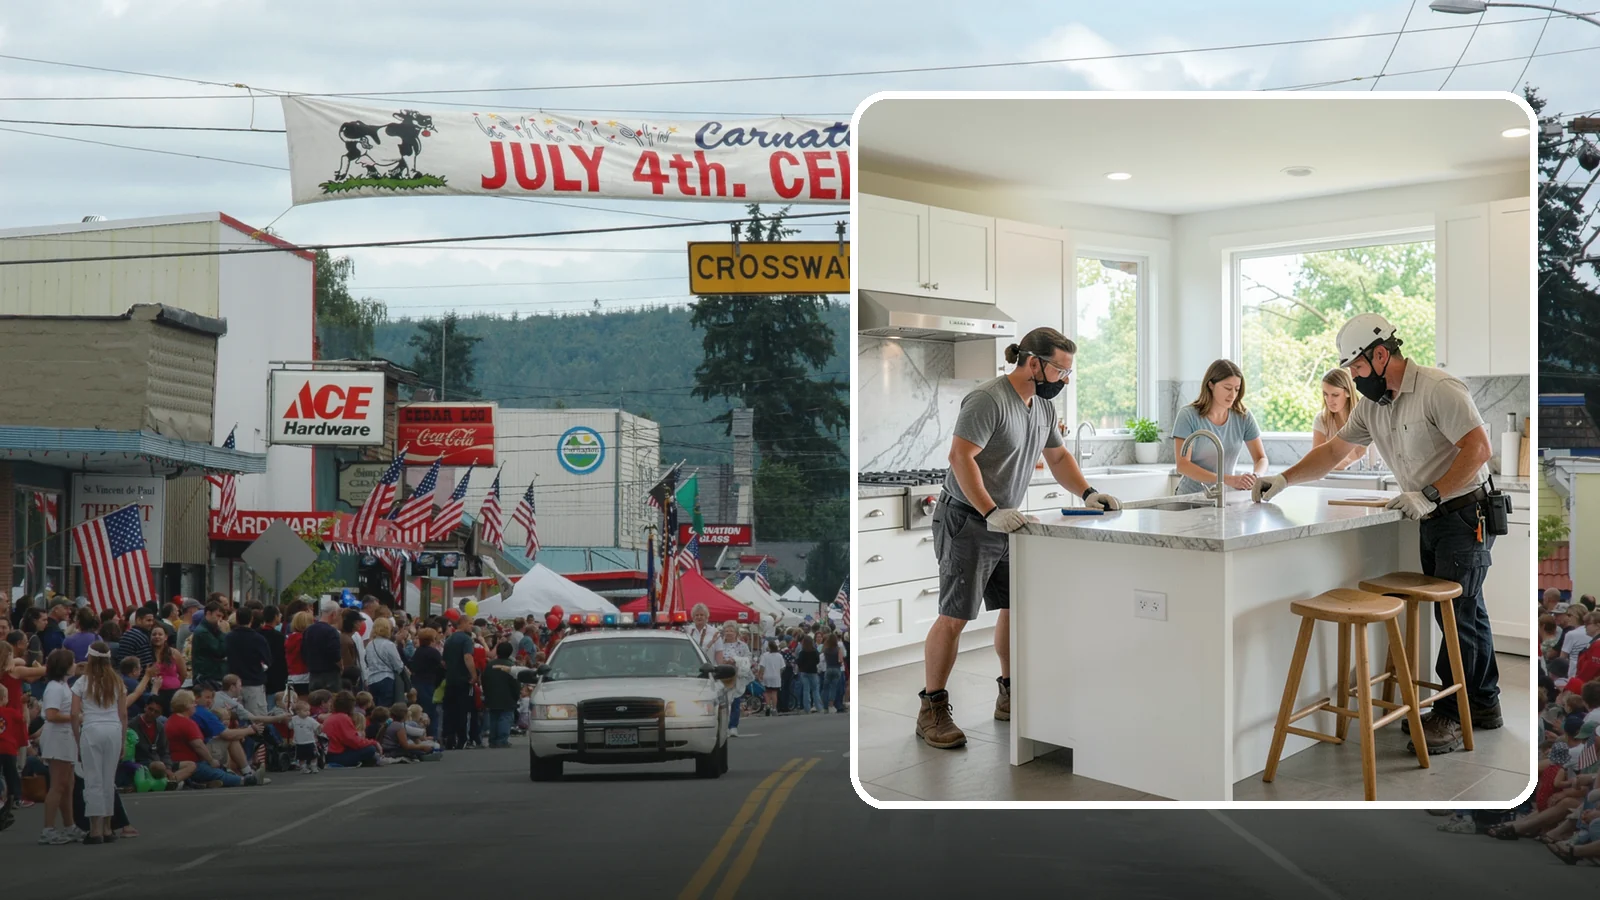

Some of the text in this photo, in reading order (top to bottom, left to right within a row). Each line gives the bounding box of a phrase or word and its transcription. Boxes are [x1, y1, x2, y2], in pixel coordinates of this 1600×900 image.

[694, 121, 850, 150] Carnat
[481, 141, 605, 192] JULY
[632, 150, 746, 197] 4th.
[696, 254, 850, 280] CROSSWA
[283, 380, 373, 420] ACE
[283, 421, 371, 437] Hardware
[416, 428, 477, 447] Coca-Cola
[353, 466, 385, 480] Simpl
[95, 485, 124, 495] Vincent
[126, 485, 136, 495] de
[137, 486, 155, 495] Paul
[688, 526, 741, 535] CRNATION
[699, 535, 730, 543] GLASS
